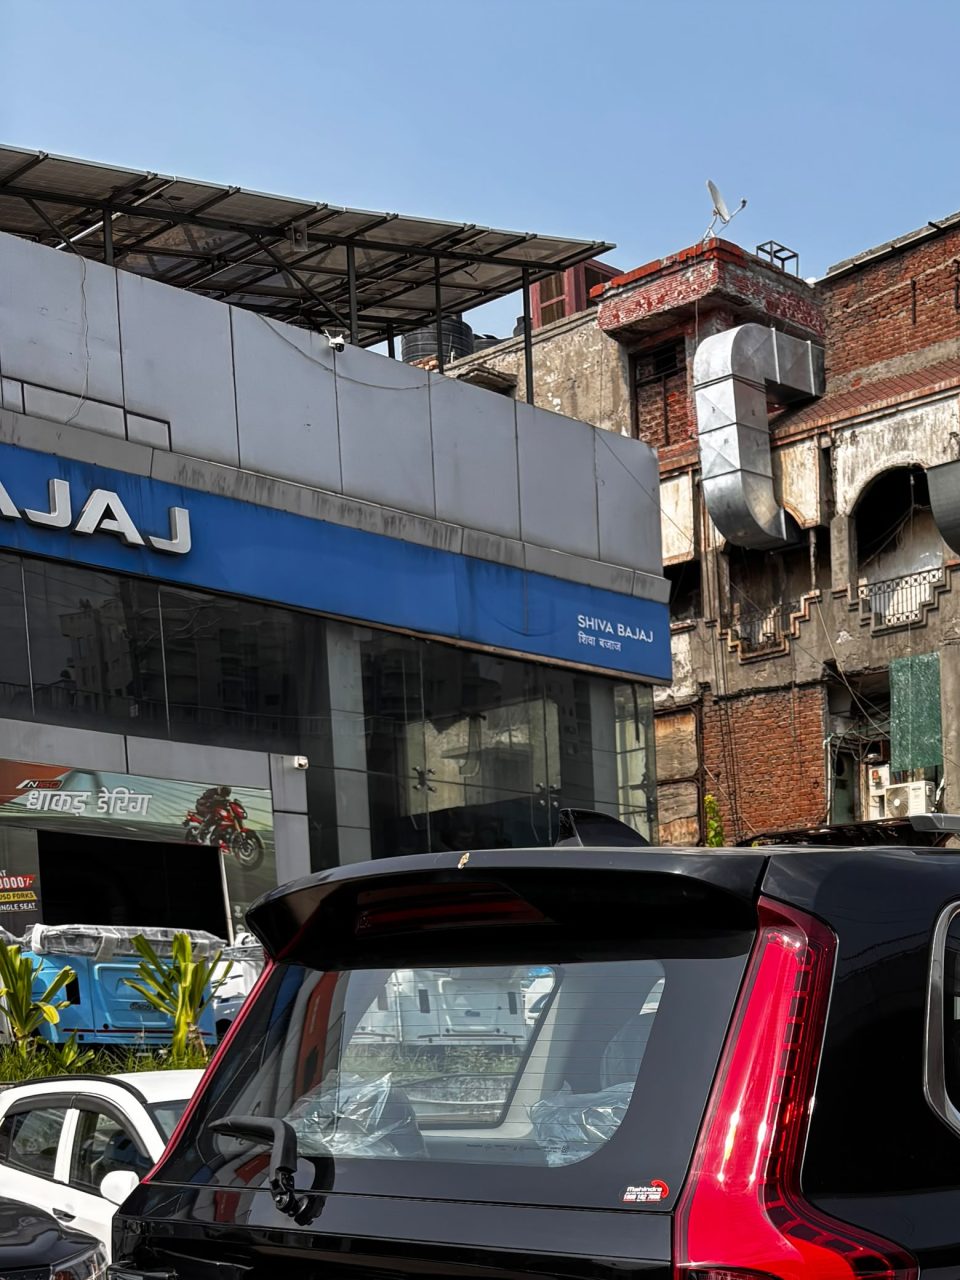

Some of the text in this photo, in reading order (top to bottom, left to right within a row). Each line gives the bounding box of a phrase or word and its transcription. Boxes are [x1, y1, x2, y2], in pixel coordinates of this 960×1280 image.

[577, 614, 654, 643] SHIVA BAJAJ
[26, 786, 153, 816] धाकड़ डेरिंग
[19, 902, 36, 910] SEAT
